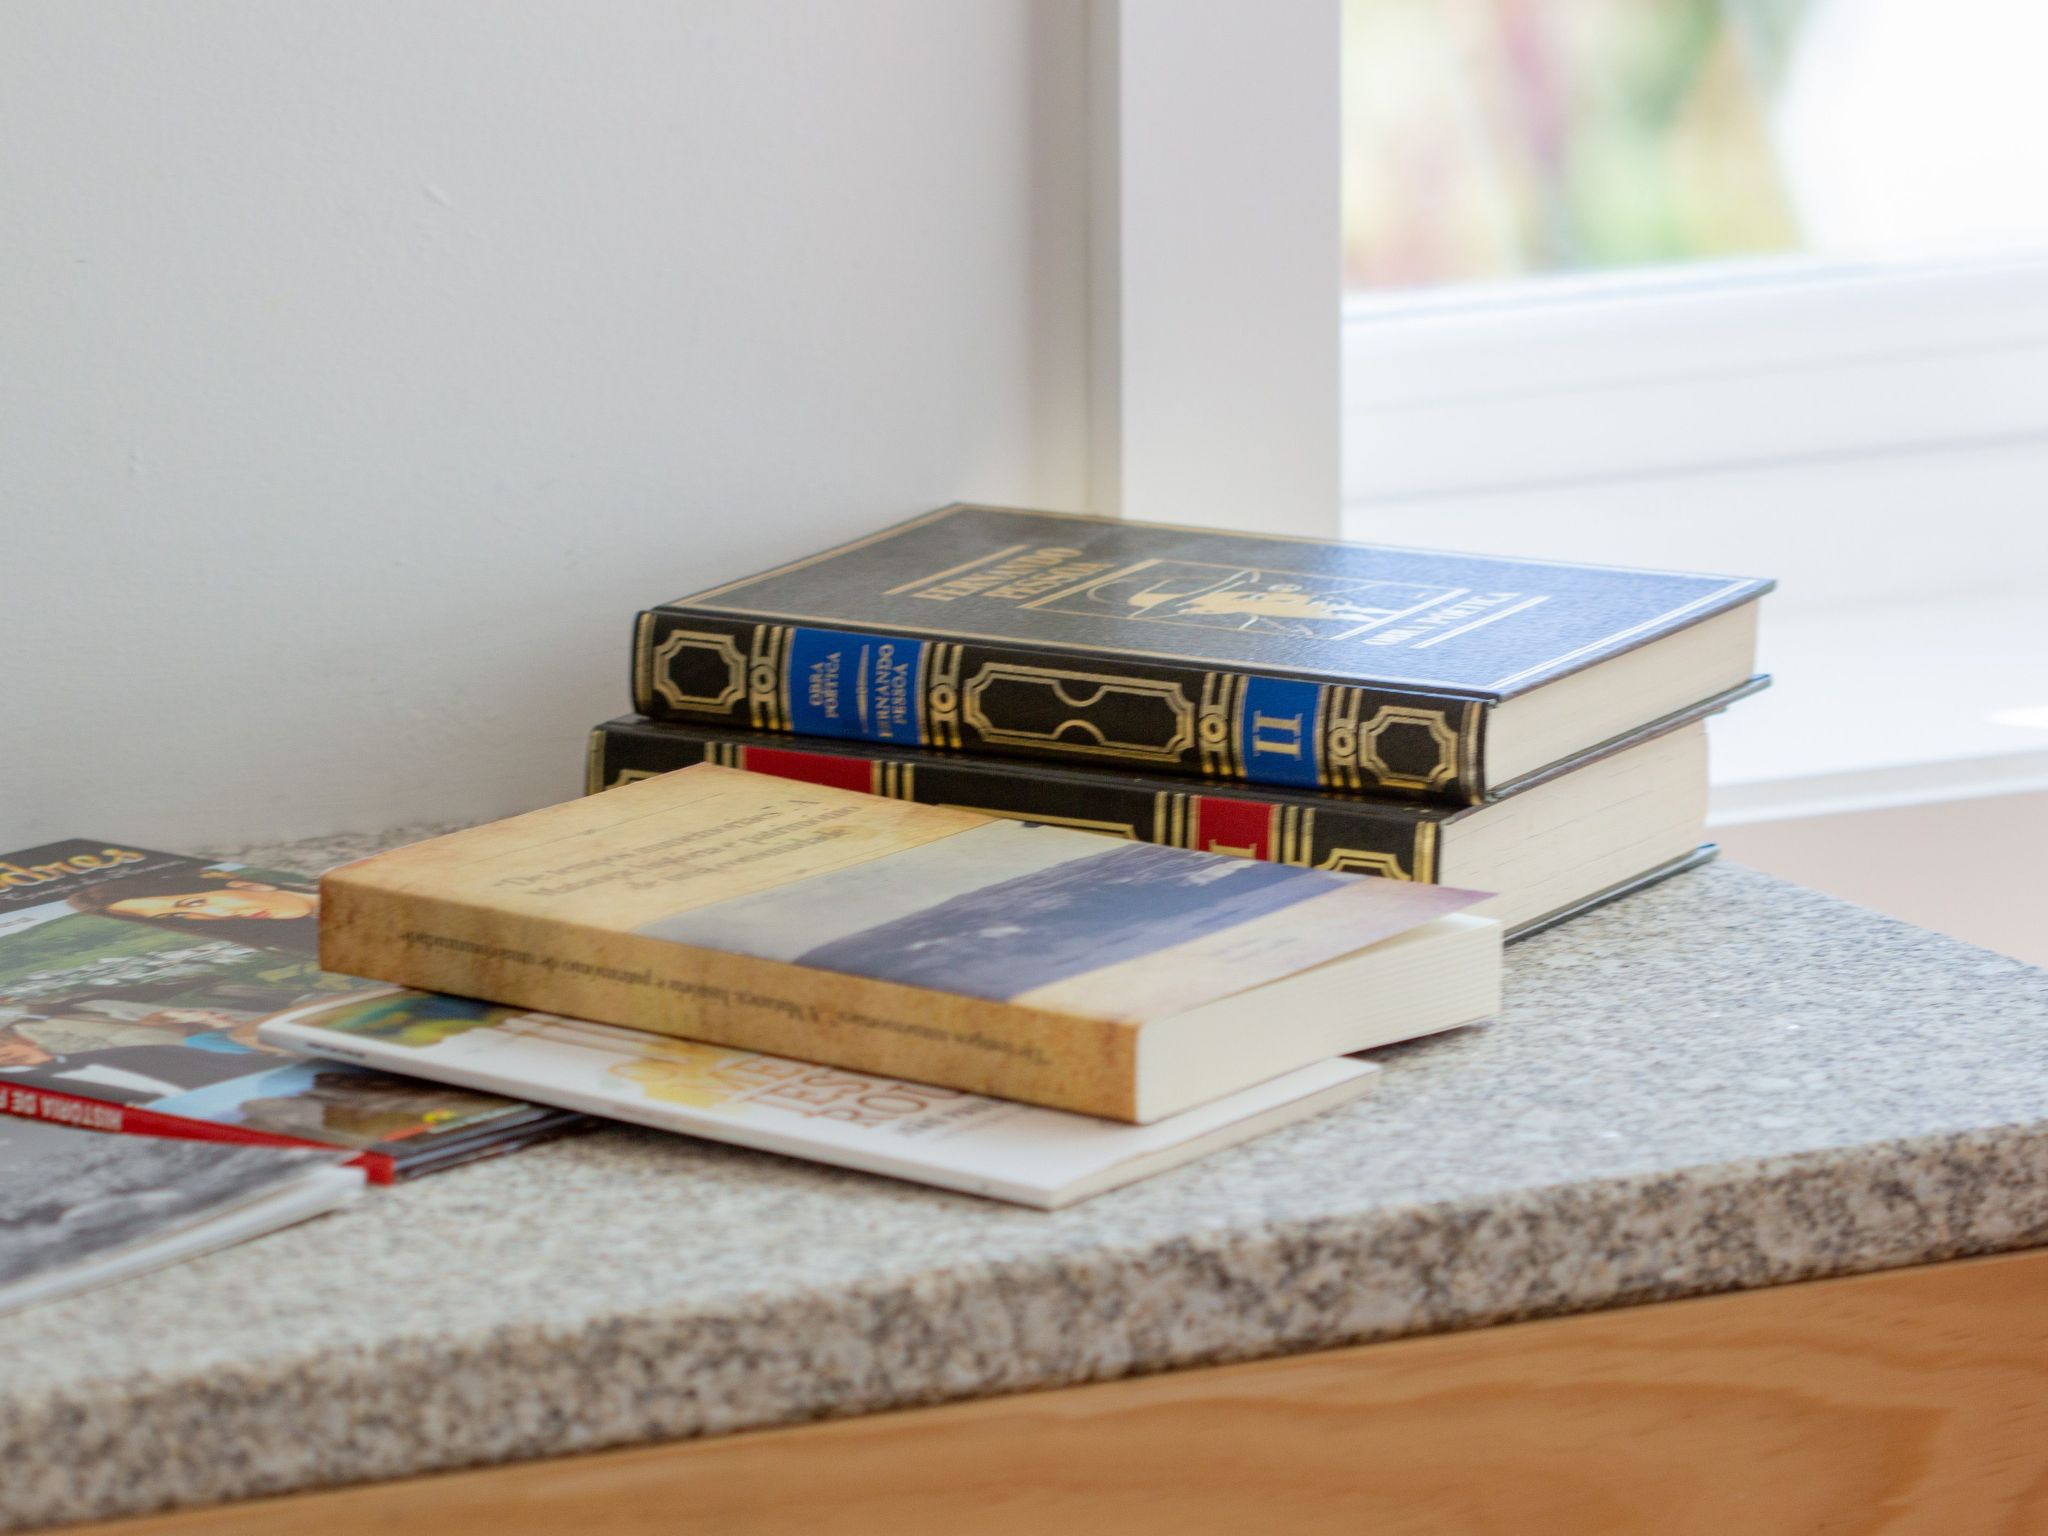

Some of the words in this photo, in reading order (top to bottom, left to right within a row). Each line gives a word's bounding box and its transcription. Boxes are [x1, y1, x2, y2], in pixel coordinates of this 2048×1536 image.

[912, 548, 1083, 600] FERNANDO
[983, 563, 1116, 599] PESSOA
[875, 644, 895, 737] FERNANDO
[891, 663, 909, 724] PESSOA
[1253, 710, 1303, 761] II
